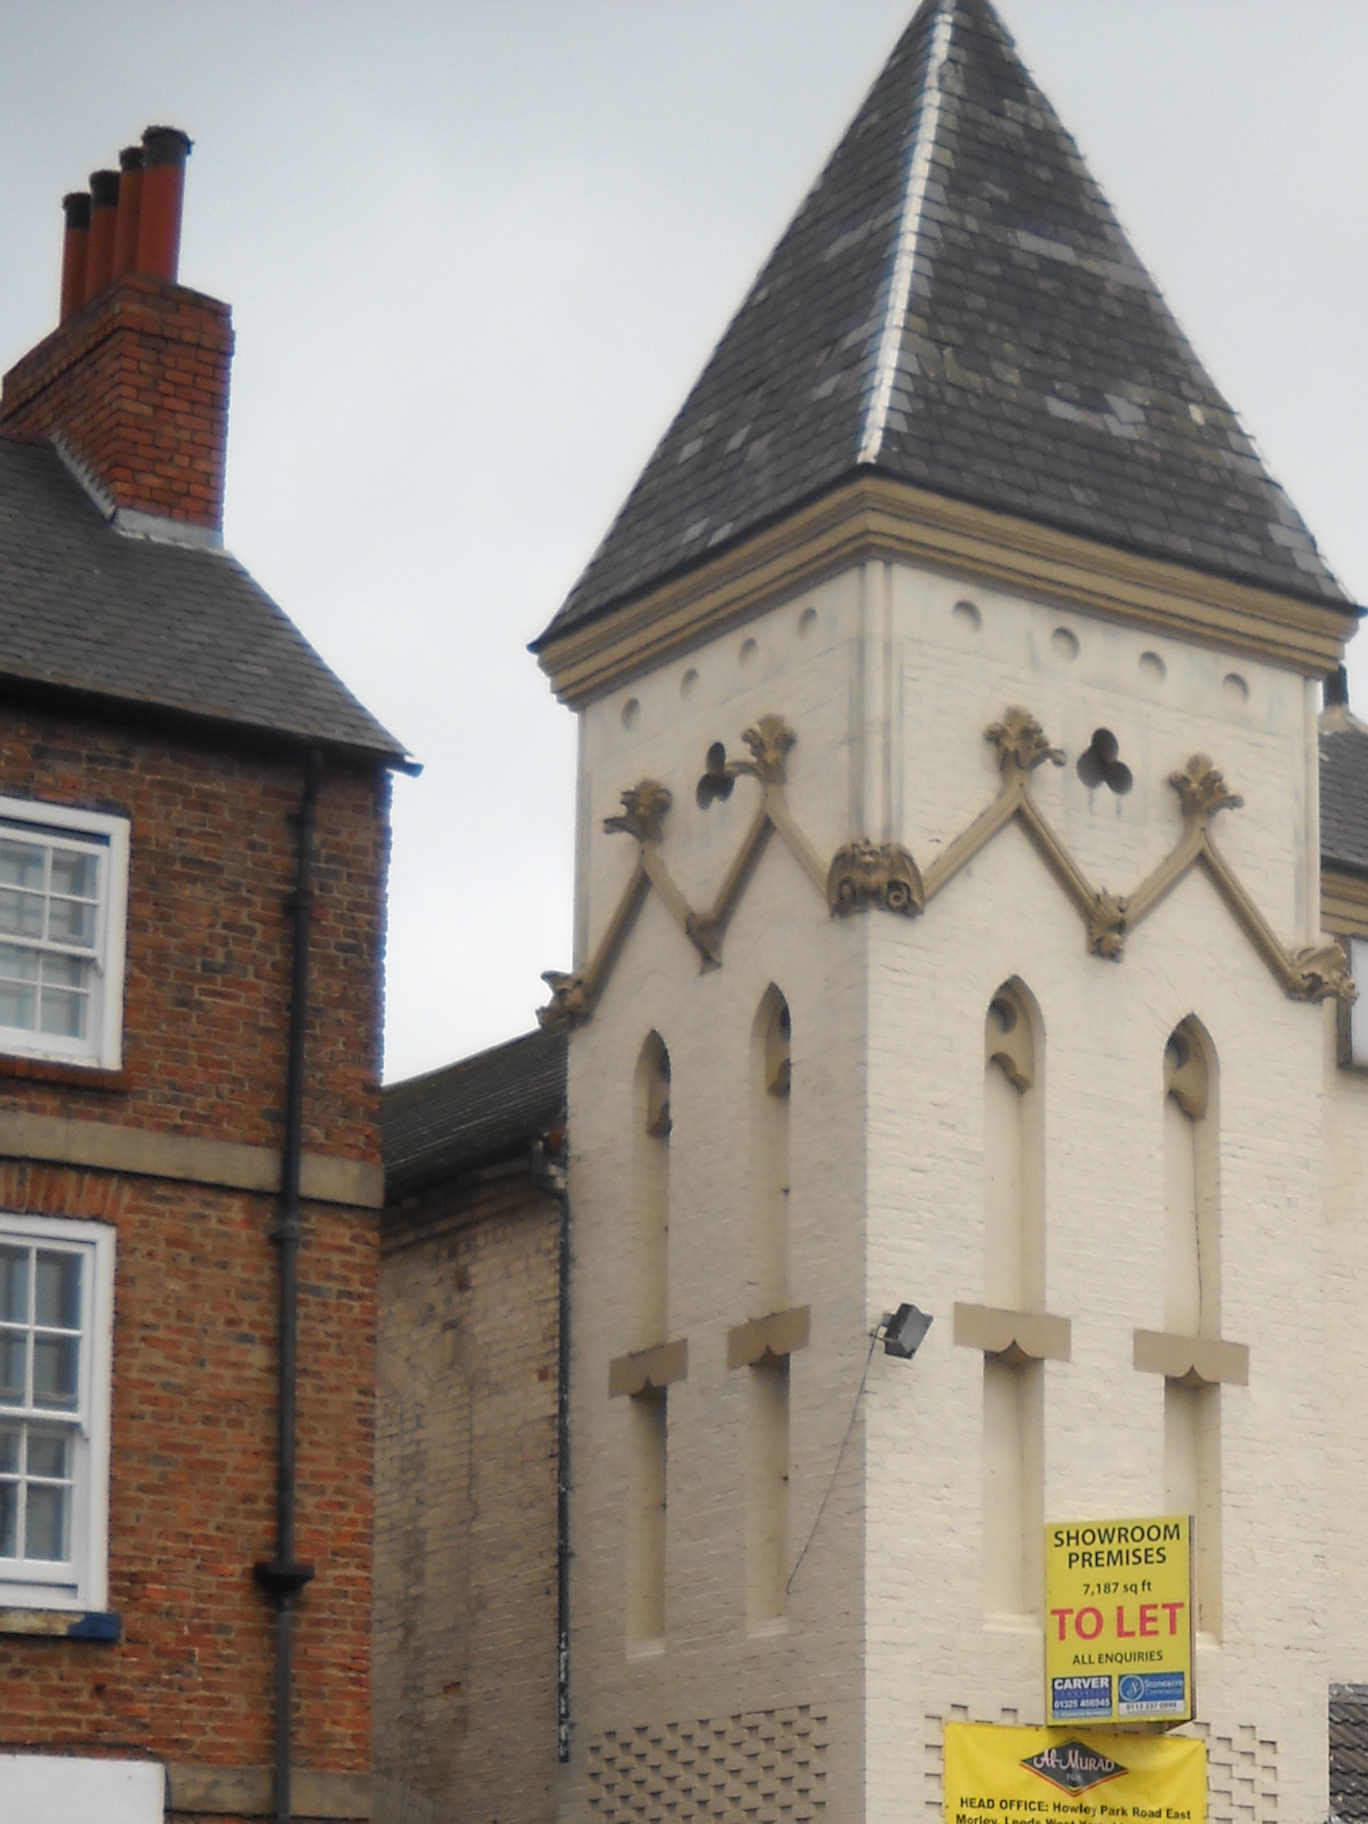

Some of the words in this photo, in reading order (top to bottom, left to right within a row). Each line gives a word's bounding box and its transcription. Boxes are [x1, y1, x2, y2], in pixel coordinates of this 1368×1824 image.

[1053, 1523, 1181, 1548] SHOWROOM
[1068, 1547, 1167, 1569] PREMISES
[1083, 1582, 1119, 1597] 7,187
[1123, 1583, 1138, 1595] sq
[1141, 1579, 1152, 1592] ft
[1050, 1606, 1104, 1641] TO
[1116, 1602, 1185, 1638] LET
[1072, 1653, 1095, 1666] ALL
[1098, 1650, 1164, 1665] ENQUIRIES
[1053, 1676, 1110, 1690] CARVER
[960, 1797, 995, 1809] HEAD
[999, 1799, 1049, 1812] OFFICE:
[1053, 1802, 1096, 1817] Howley
[1101, 1805, 1128, 1817] Park
[1132, 1807, 1162, 1818] Road
[1166, 1808, 1191, 1819] East
